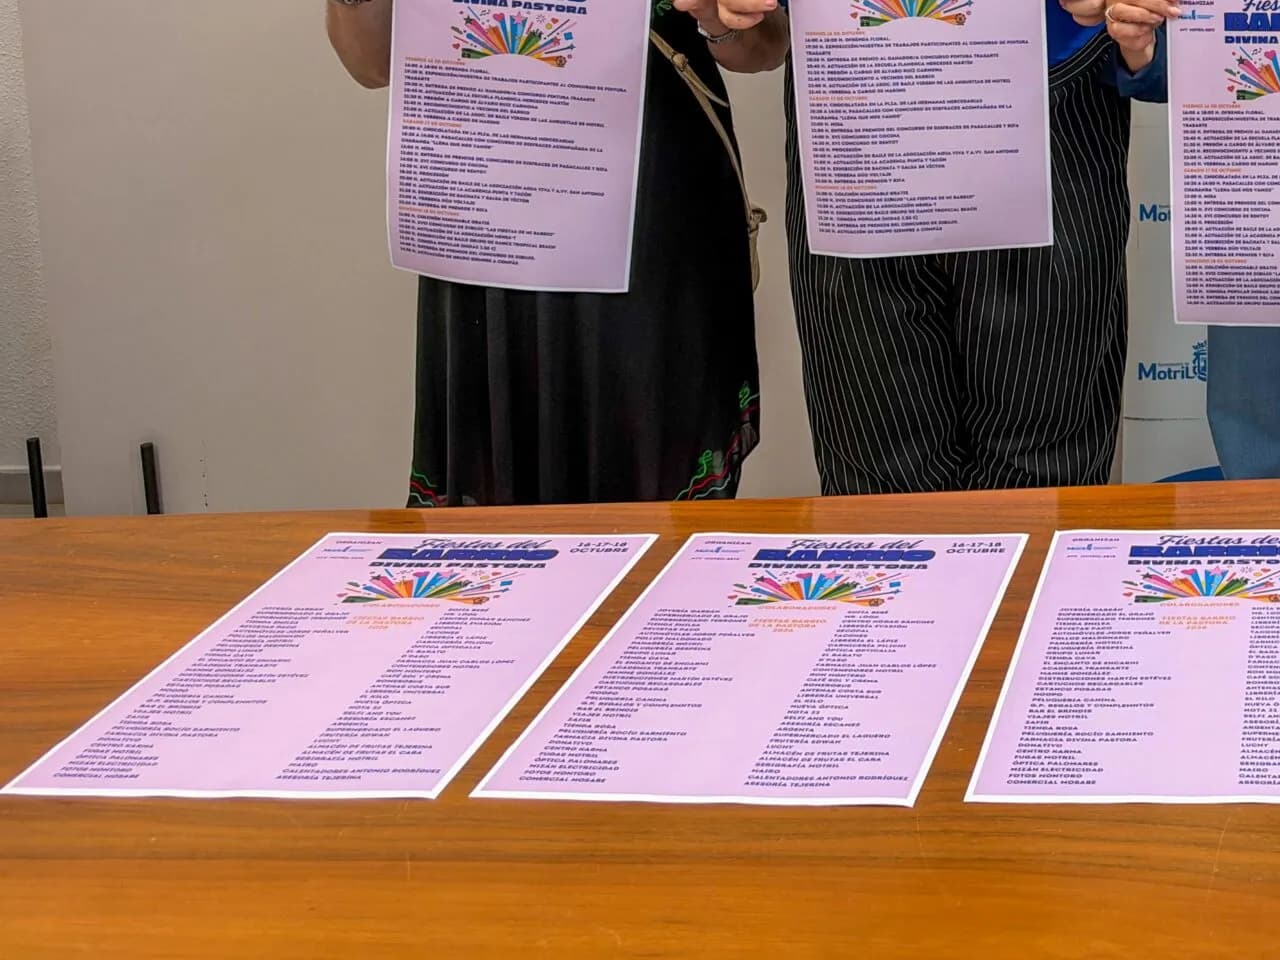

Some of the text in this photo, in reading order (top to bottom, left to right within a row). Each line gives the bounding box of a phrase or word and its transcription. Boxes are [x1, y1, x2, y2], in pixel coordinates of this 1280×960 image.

[512, 0, 587, 14] PASTORA
[1225, 36, 1278, 44] DIVINA
[787, 539, 925, 549] Fiestas del
[1158, 535, 1248, 546] Fiestas
[753, 549, 935, 562] BARRIO
